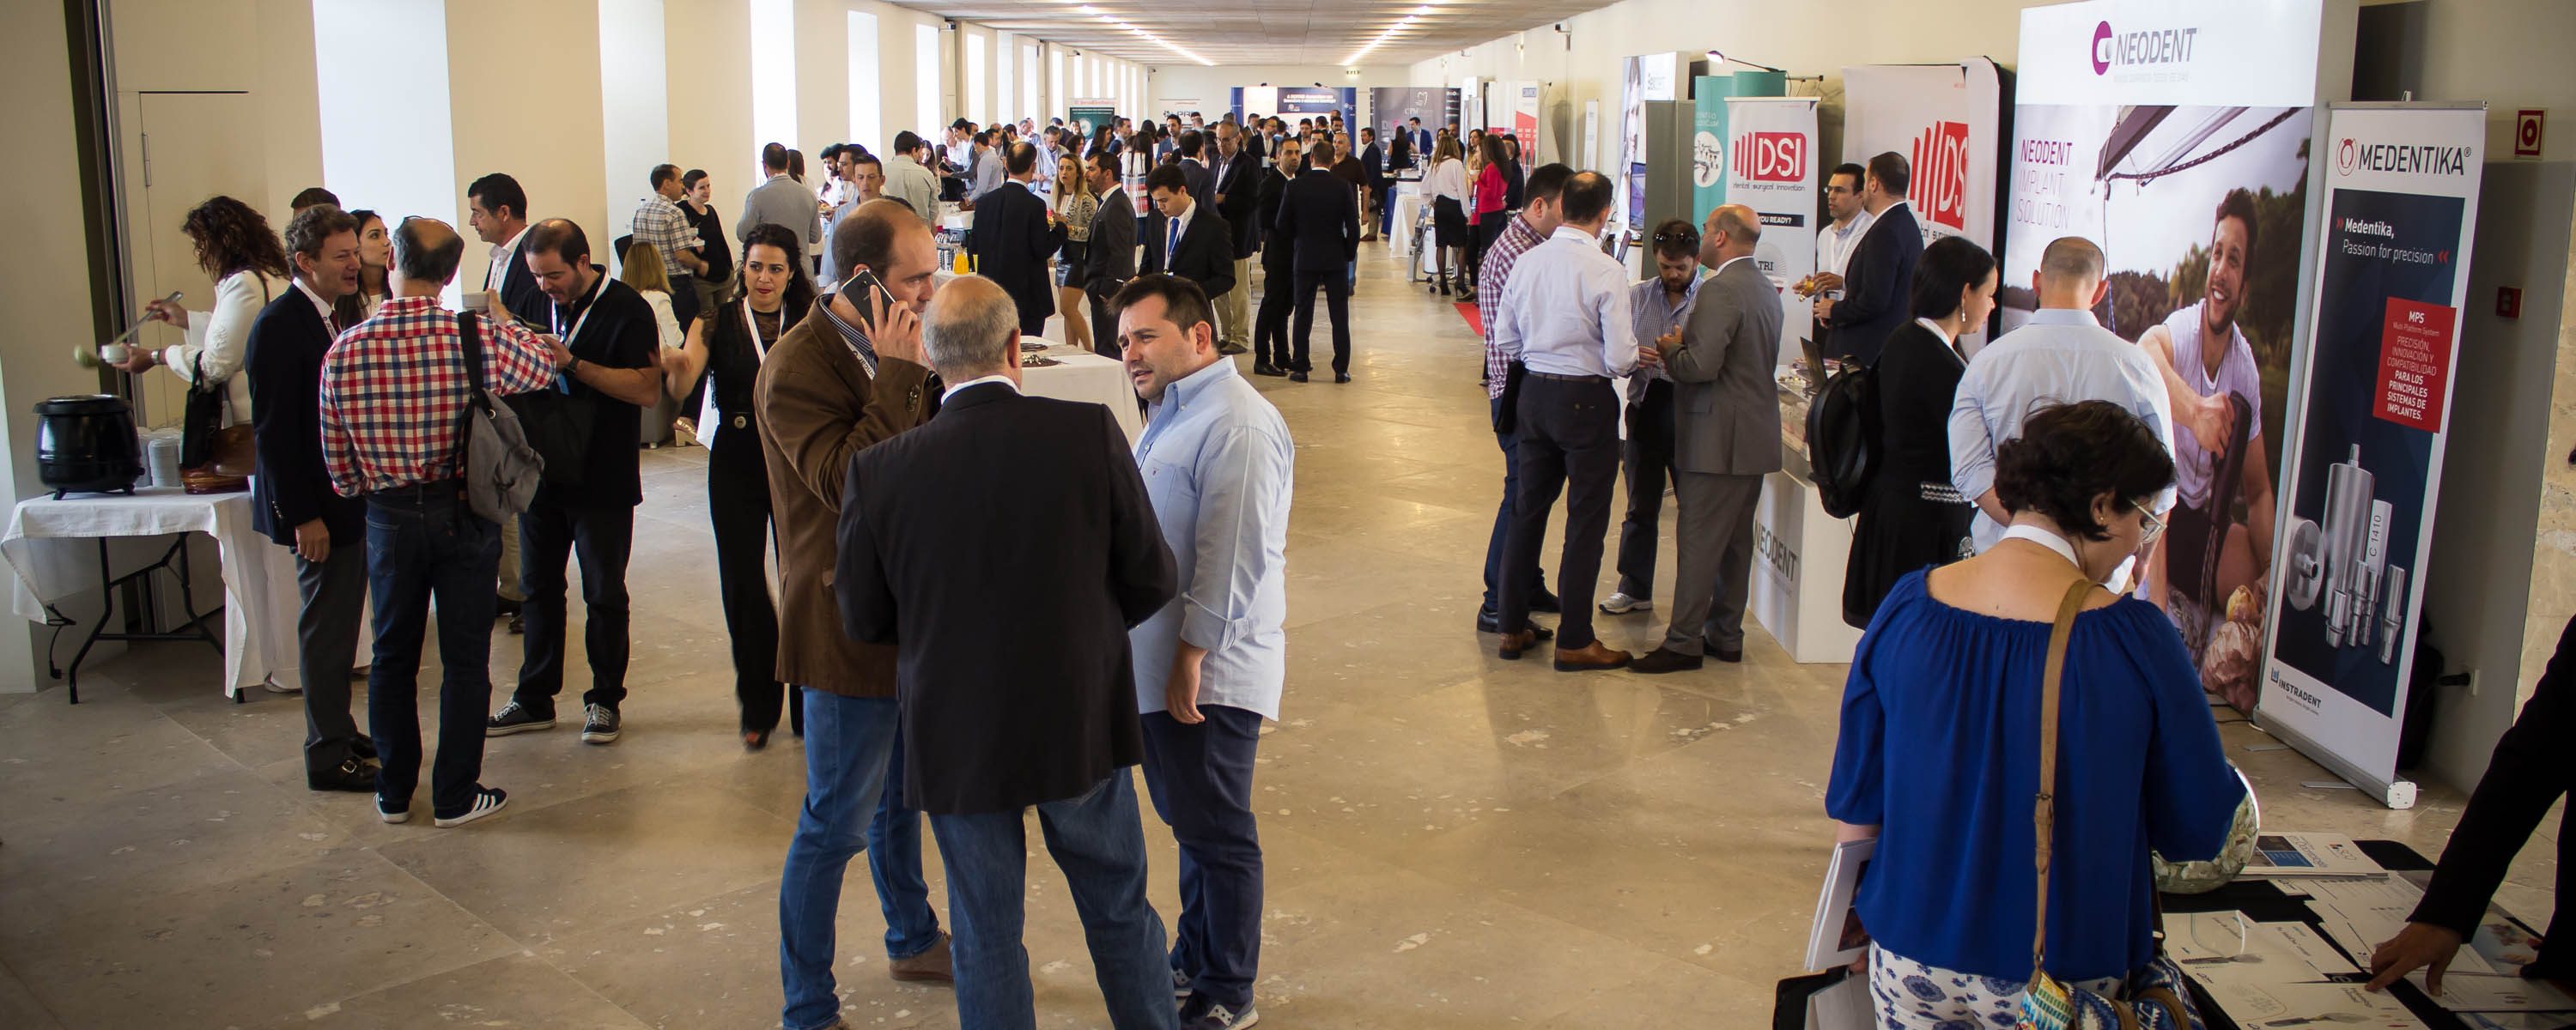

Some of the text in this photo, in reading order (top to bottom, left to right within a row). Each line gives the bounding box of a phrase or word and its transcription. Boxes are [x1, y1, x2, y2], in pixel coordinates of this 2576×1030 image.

[2115, 27, 2197, 65] NEODENT
[1758, 137, 1801, 178] DSI
[2020, 139, 2072, 166] NEODENT
[2018, 170, 2064, 197] IMPLANT
[1770, 215, 1792, 225] READY?
[2016, 198, 2070, 230] SOLUTION
[2345, 217, 2395, 239] Medentika,
[2342, 239, 2434, 264] Passion for precision
[1758, 260, 1773, 271] TRI
[2409, 311, 2425, 324] MPS
[2387, 356, 2437, 376] COMPATIBILIDAD
[2429, 353, 2434, 363] Y
[2388, 380, 2428, 397] PRINCIPALES
[2395, 370, 2424, 385] PARA LOS
[2387, 391, 2427, 409] SISTEMAS DE
[2387, 403, 2423, 421] IMPLANTES.
[2371, 515, 2381, 542] 1410
[1753, 518, 1797, 582] NEODENT
[2278, 678, 2321, 708] INSTRADENT
